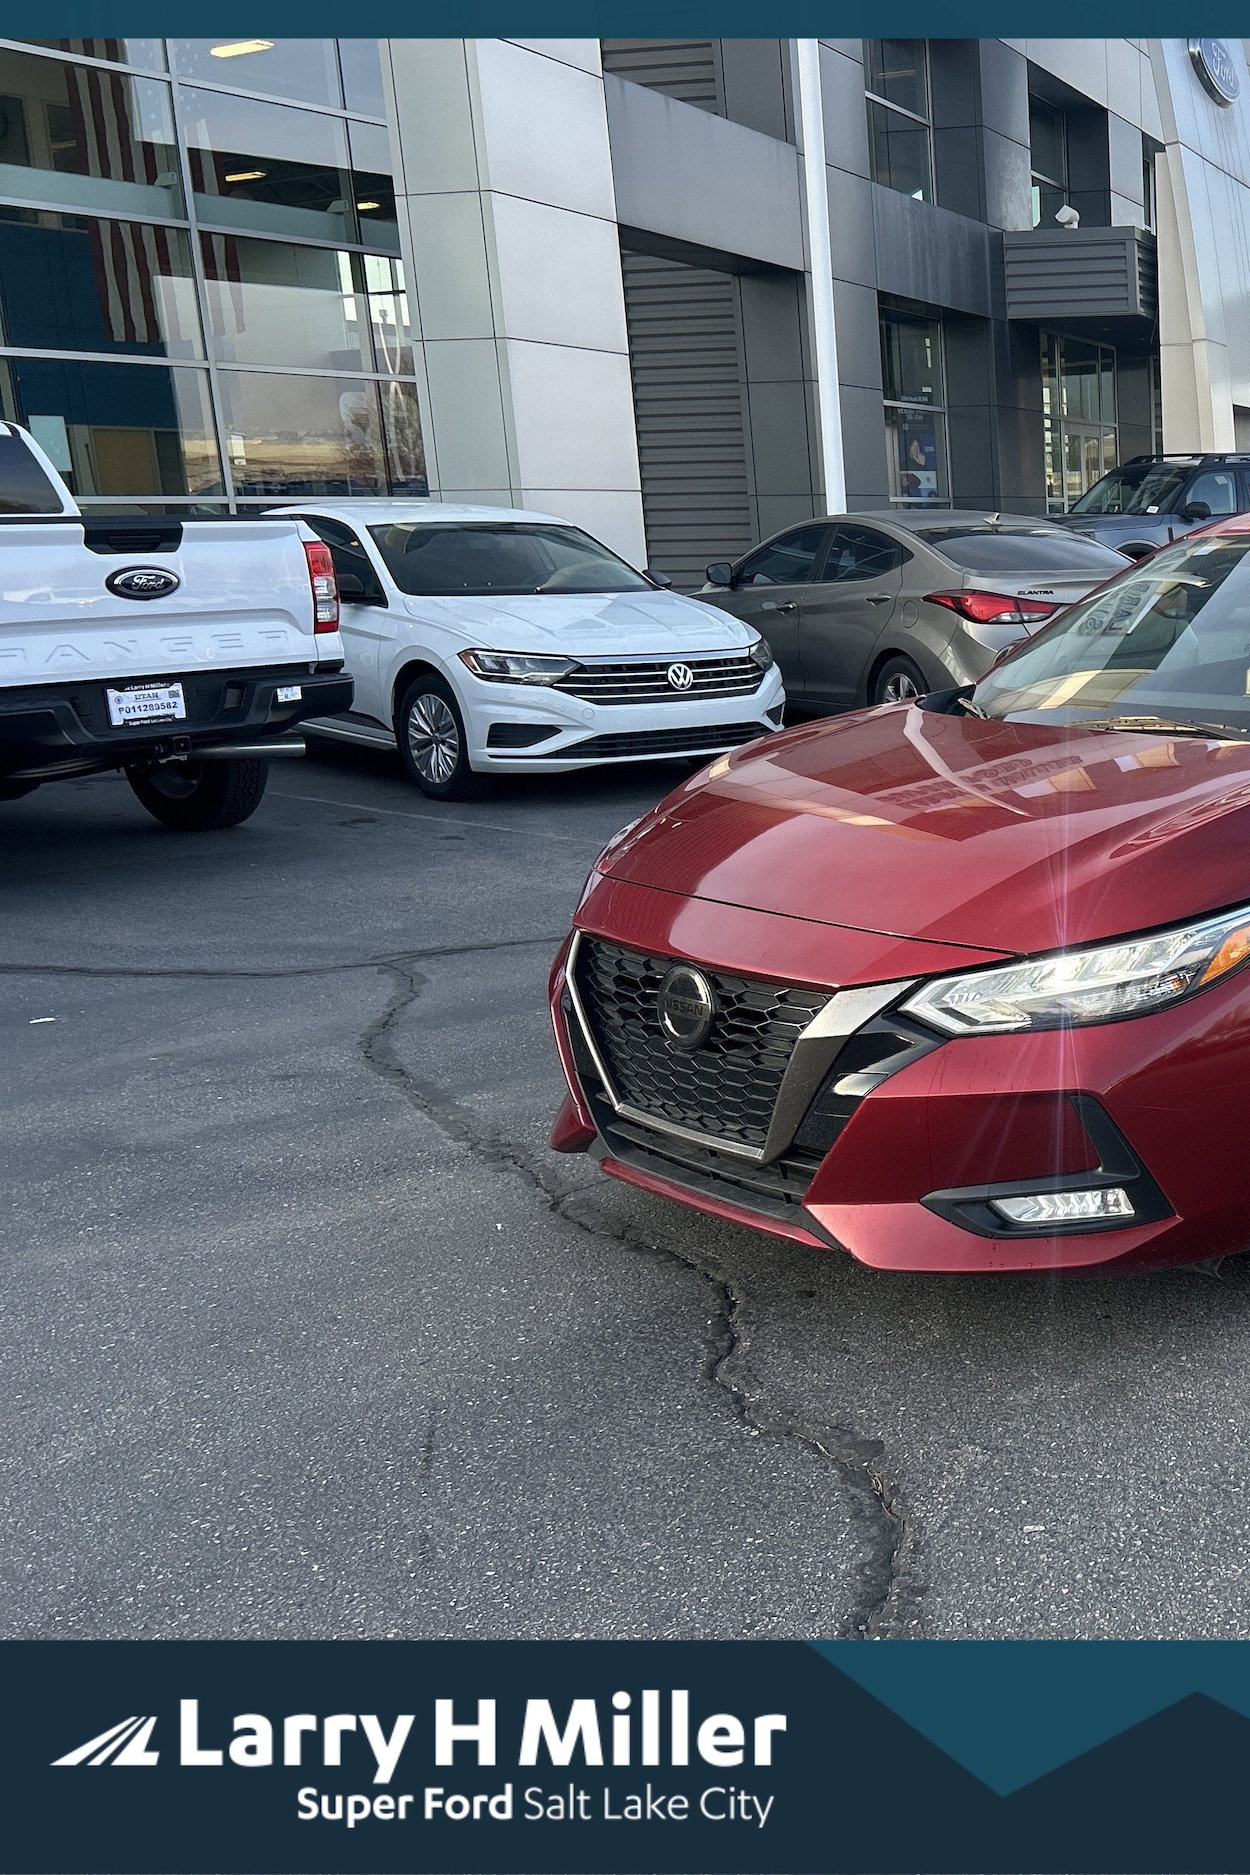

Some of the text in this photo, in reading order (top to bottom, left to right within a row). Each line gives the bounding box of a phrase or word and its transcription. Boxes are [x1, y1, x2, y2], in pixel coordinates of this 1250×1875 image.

[1210, 41, 1235, 88] Ford
[131, 574, 165, 592] Ford
[134, 693, 159, 701] UTAH
[665, 996, 704, 1016] NISSAN
